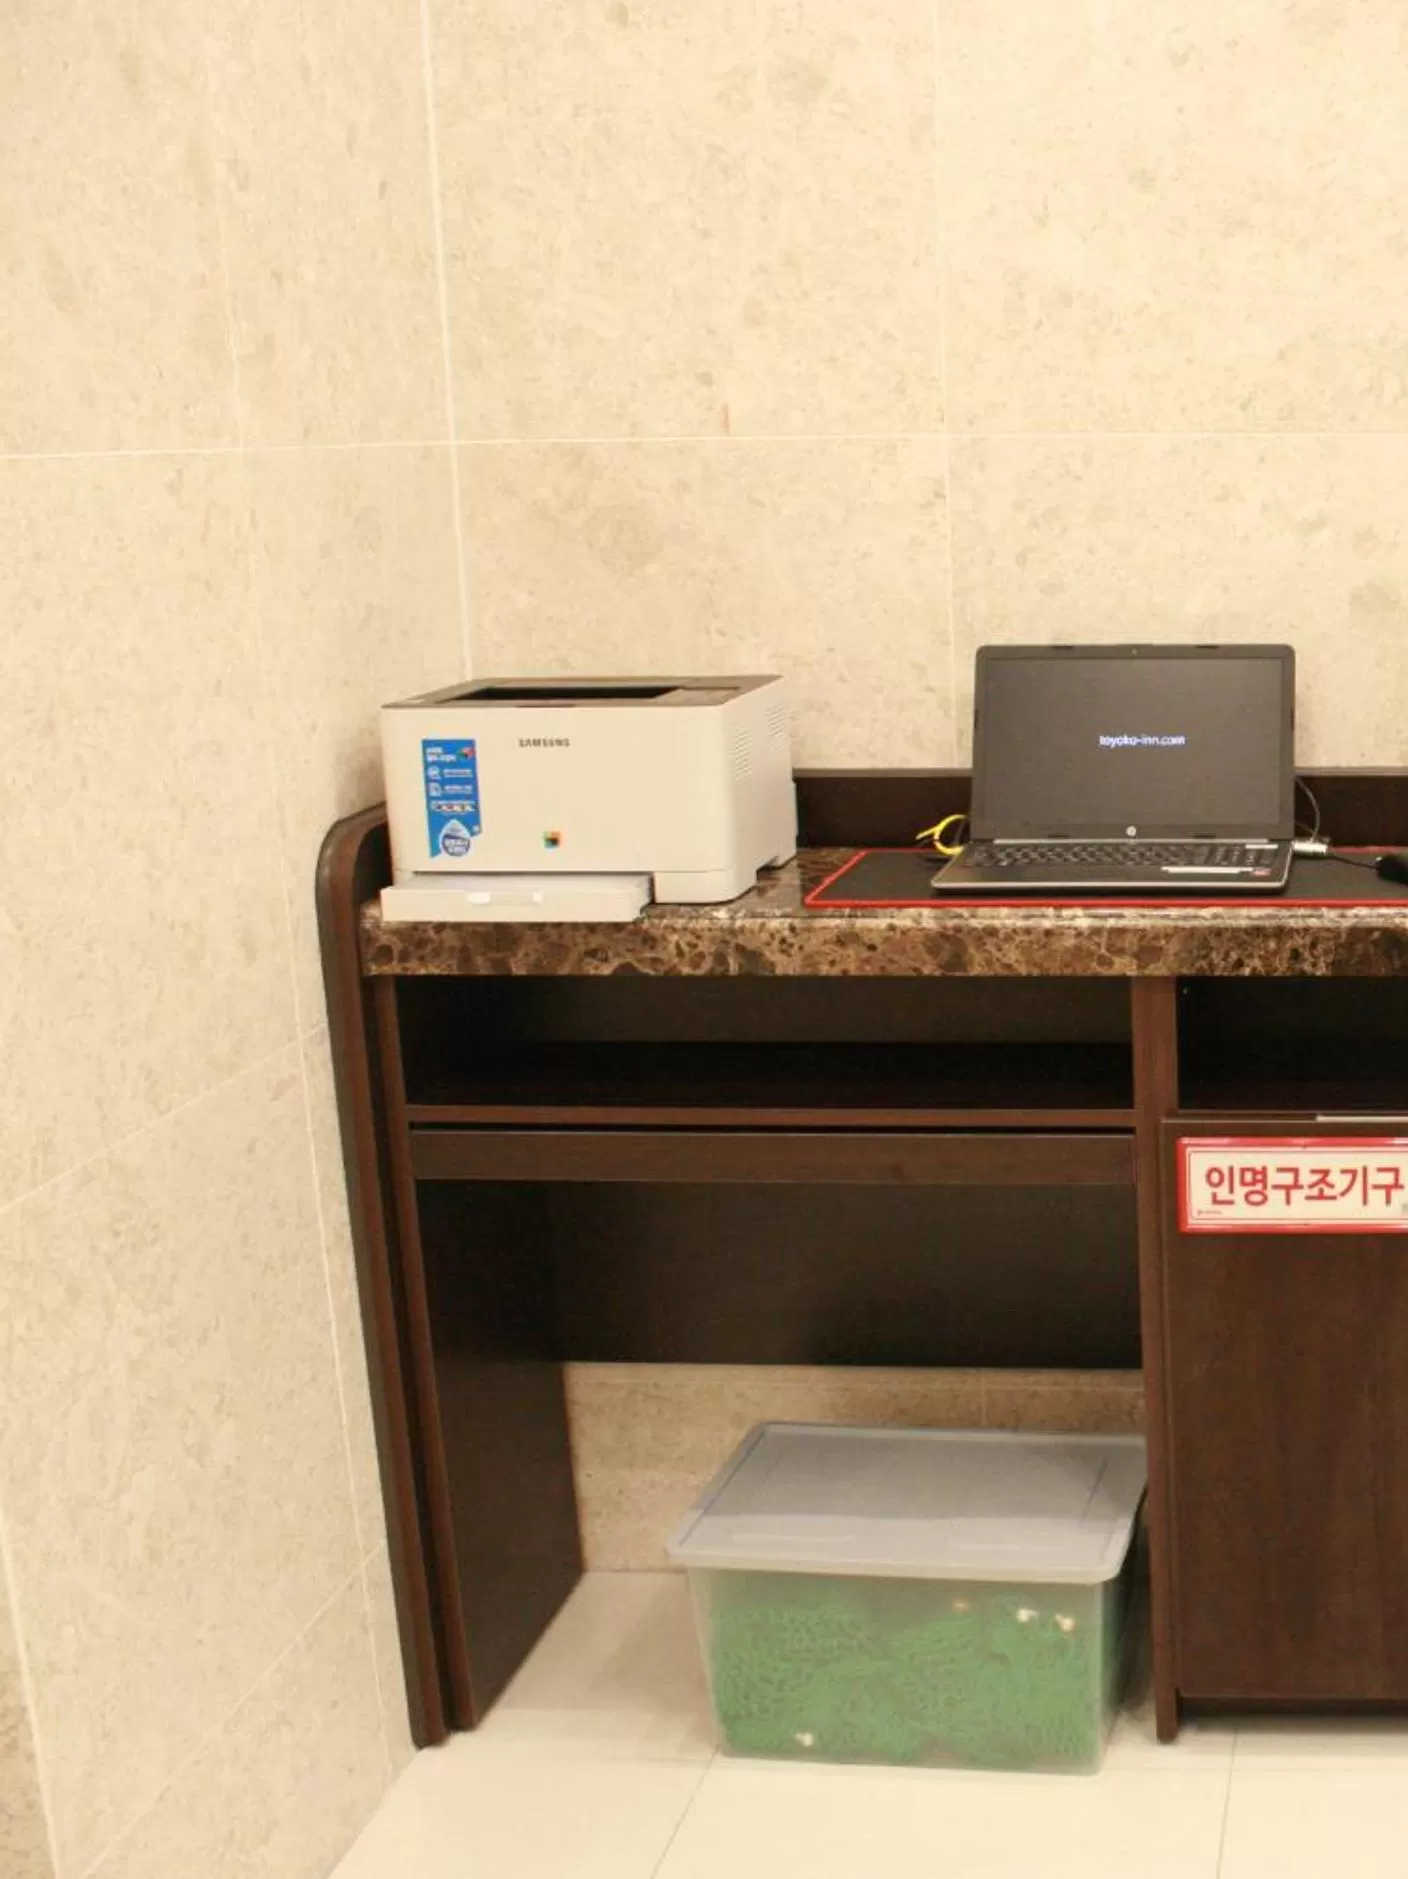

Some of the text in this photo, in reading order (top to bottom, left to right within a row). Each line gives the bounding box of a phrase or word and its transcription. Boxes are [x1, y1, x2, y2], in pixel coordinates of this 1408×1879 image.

[518, 737, 570, 748] SAMSUNG
[1099, 733, 1186, 749] toyoko-inn.com
[1205, 1165, 1405, 1206] 인명구조기구
